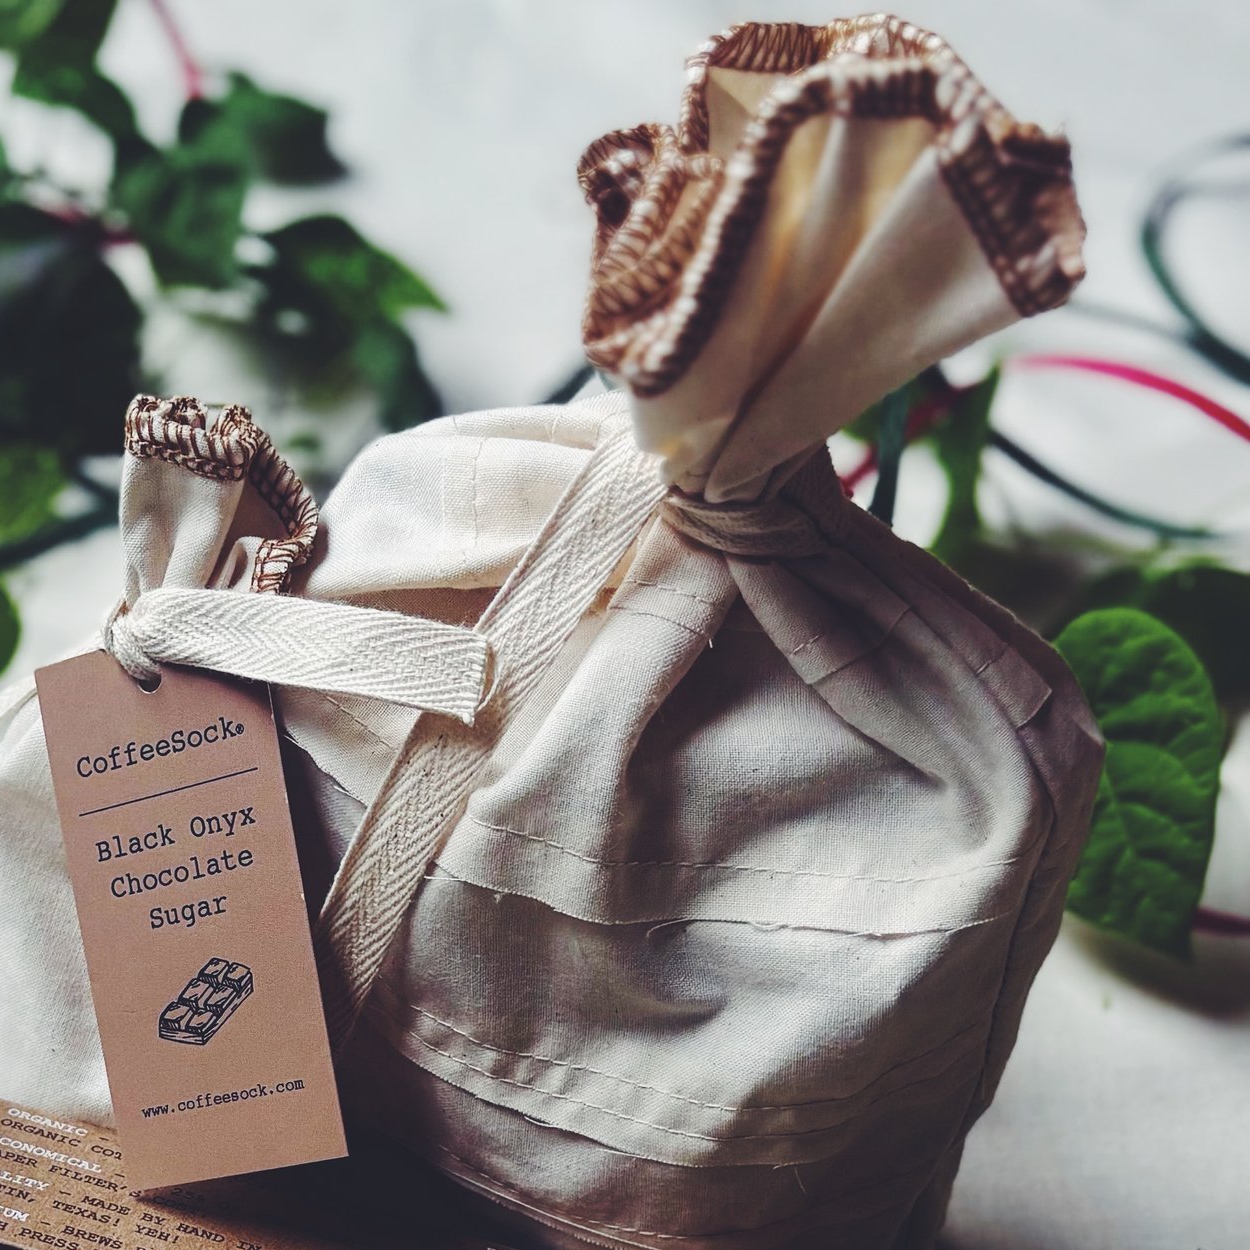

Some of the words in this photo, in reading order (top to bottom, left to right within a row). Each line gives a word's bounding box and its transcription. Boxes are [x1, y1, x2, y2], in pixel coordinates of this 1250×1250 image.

[95, 823, 176, 863] Black
[190, 807, 256, 837] Onyx
[110, 849, 254, 898] Chocolate
[150, 895, 227, 930] Sugar
[141, 1078, 305, 1119] www.coffeesock.com
[0, 1118, 81, 1147] ORGANIC
[8, 1107, 88, 1138] ORGANIC
[52, 1200, 120, 1227] TEXAS!
[135, 1225, 180, 1244] YEH!
[62, 1225, 124, 1250] BREWS
[81, 1194, 132, 1216] MADE
[140, 1212, 167, 1226] BY
[176, 1222, 226, 1243] HAND
